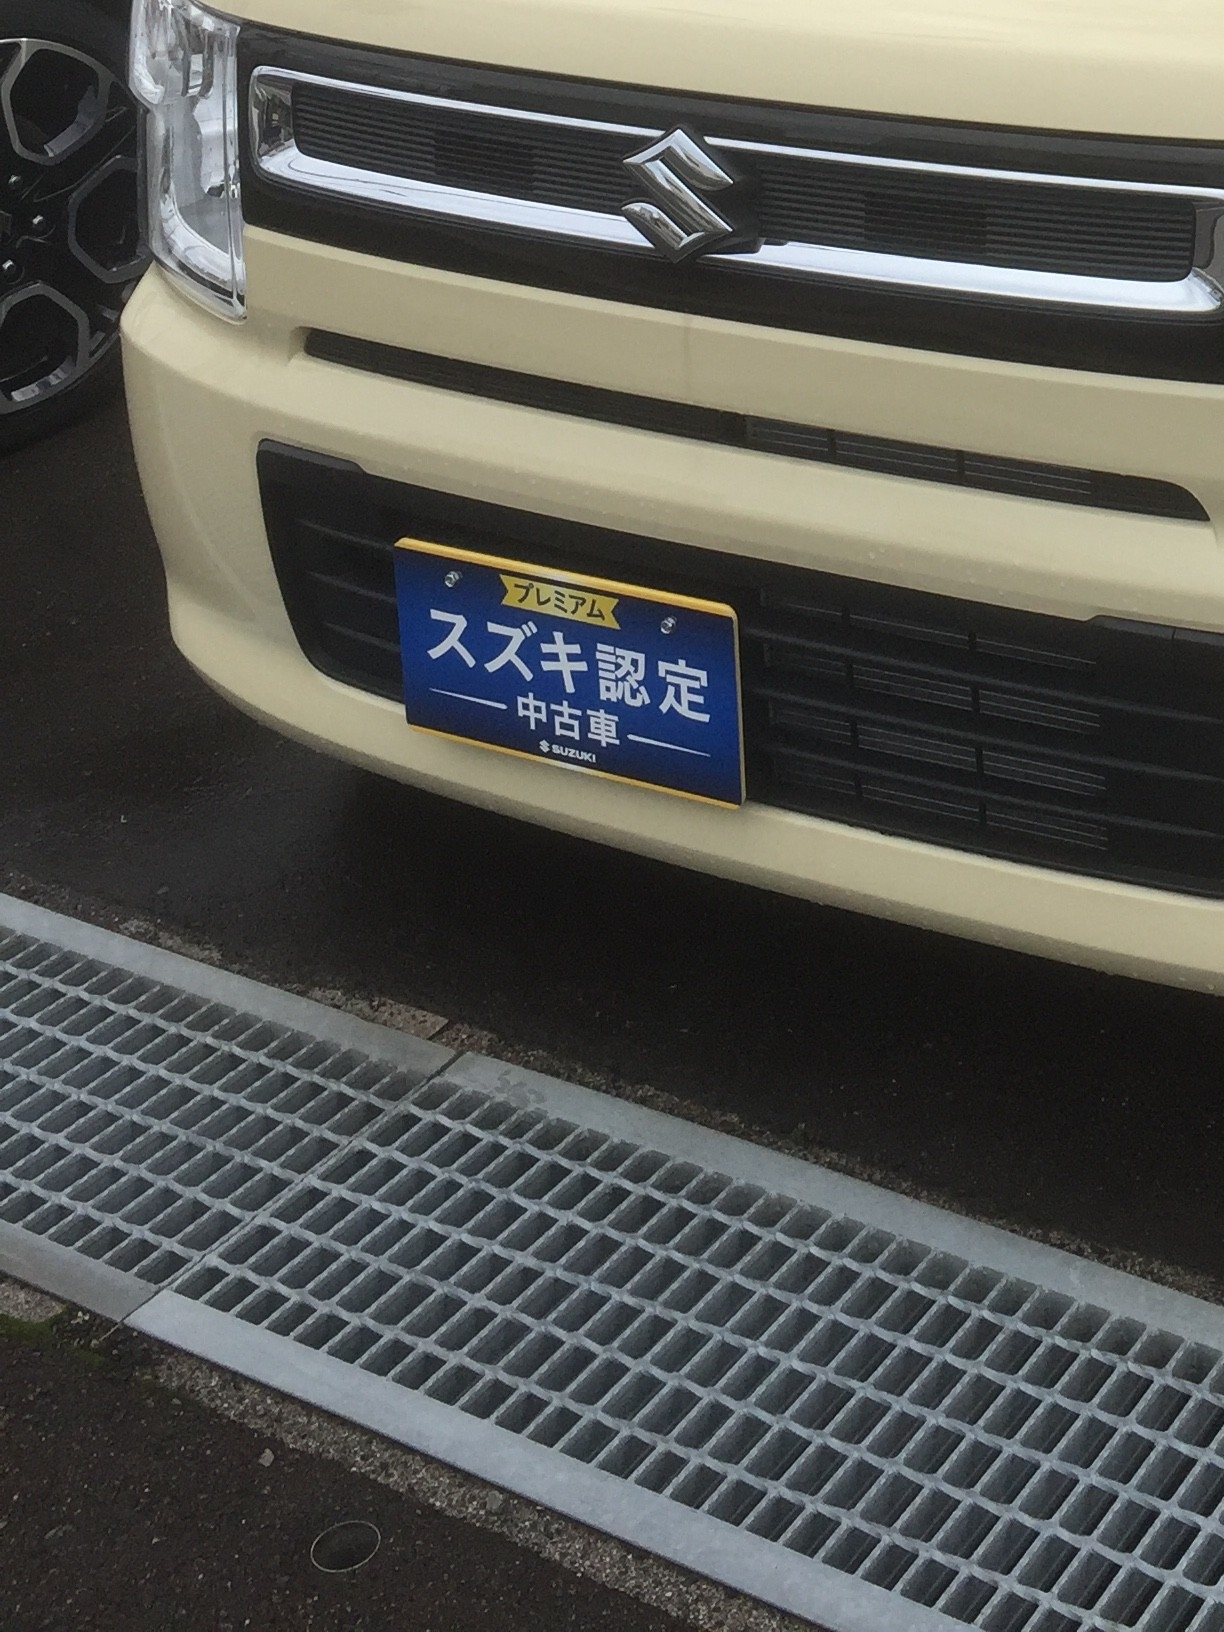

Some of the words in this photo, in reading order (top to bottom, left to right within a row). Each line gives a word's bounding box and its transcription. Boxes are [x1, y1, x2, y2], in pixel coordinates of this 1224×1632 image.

[513, 581, 606, 621] プレミアム
[426, 607, 711, 724] スズキ認定
[516, 691, 620, 748] 中古車
[551, 743, 597, 764] SUZUKI
